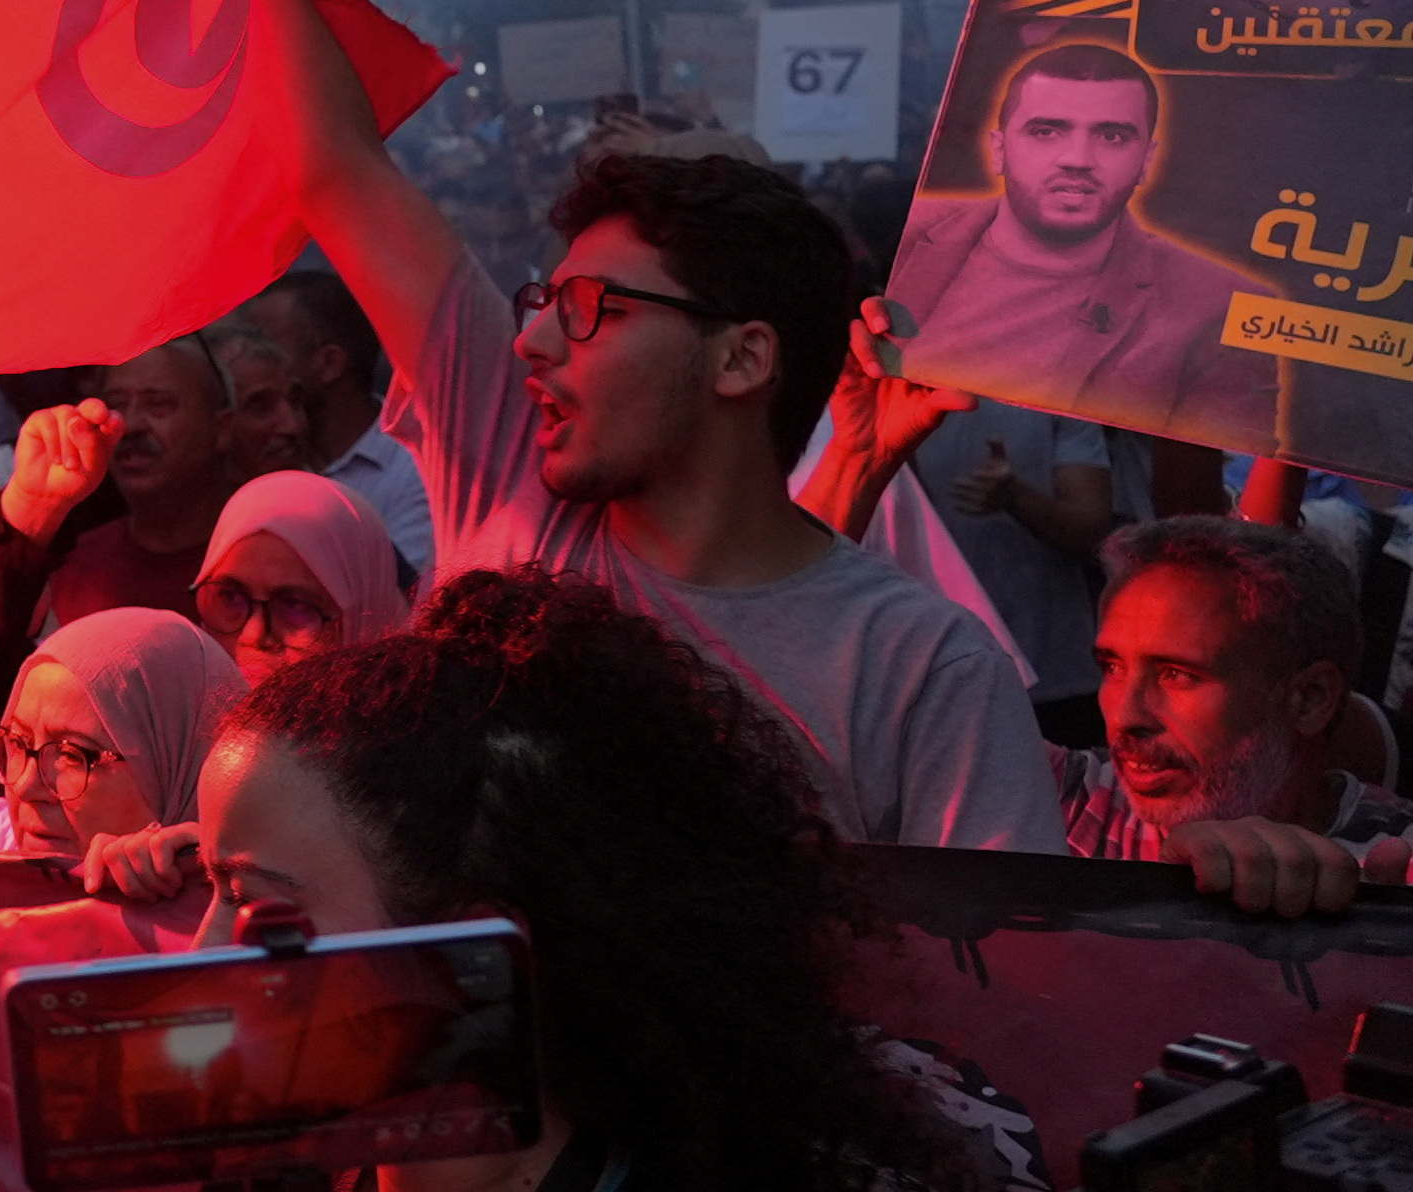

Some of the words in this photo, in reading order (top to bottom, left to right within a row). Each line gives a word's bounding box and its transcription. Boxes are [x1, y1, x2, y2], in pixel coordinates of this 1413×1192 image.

[786, 45, 869, 94] 67
[1250, 188, 1413, 302] رية
[1240, 315, 1340, 345] الخياري
